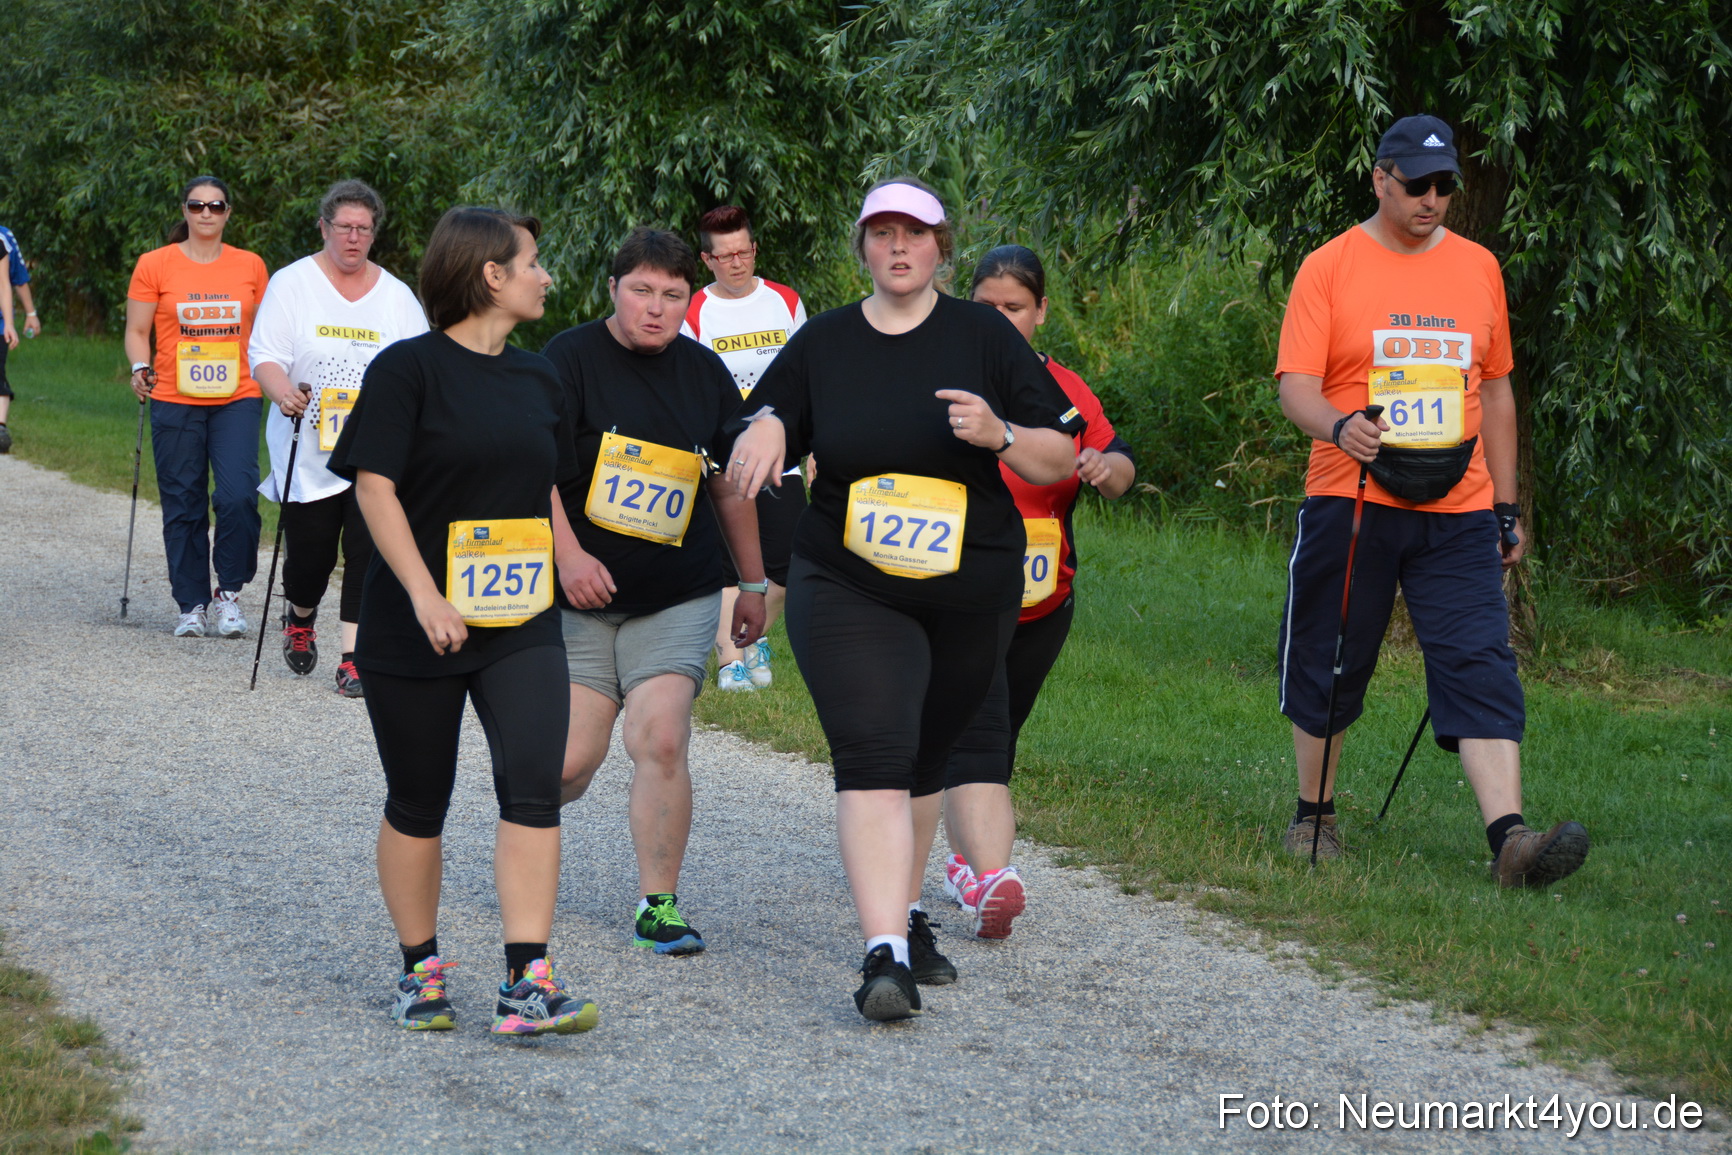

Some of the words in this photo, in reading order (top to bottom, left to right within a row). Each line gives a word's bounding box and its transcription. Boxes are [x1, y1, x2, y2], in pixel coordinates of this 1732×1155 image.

[187, 293, 201, 301] 30
[182, 306, 236, 320] OBI
[1389, 313, 1411, 326] 30
[1416, 314, 1456, 328] Jahre
[180, 325, 241, 336] Neumarkt
[319, 326, 375, 340] ONLINE
[351, 340, 380, 350] Germany
[716, 332, 782, 351] ONLINE
[1382, 336, 1464, 360] OBI
[190, 364, 227, 382] 608
[1389, 397, 1443, 426] 611
[616, 451, 654, 466] firmenlauf
[604, 474, 685, 519] 1270
[868, 486, 909, 499] firmenlauf
[618, 513, 642, 525] Brigitte
[860, 511, 951, 554] 1272
[466, 537, 504, 547] firmenlauf
[873, 551, 899, 561] Monika
[899, 554, 928, 565] Gassner
[461, 561, 544, 598] 1257
[474, 604, 507, 612] Madeleine
